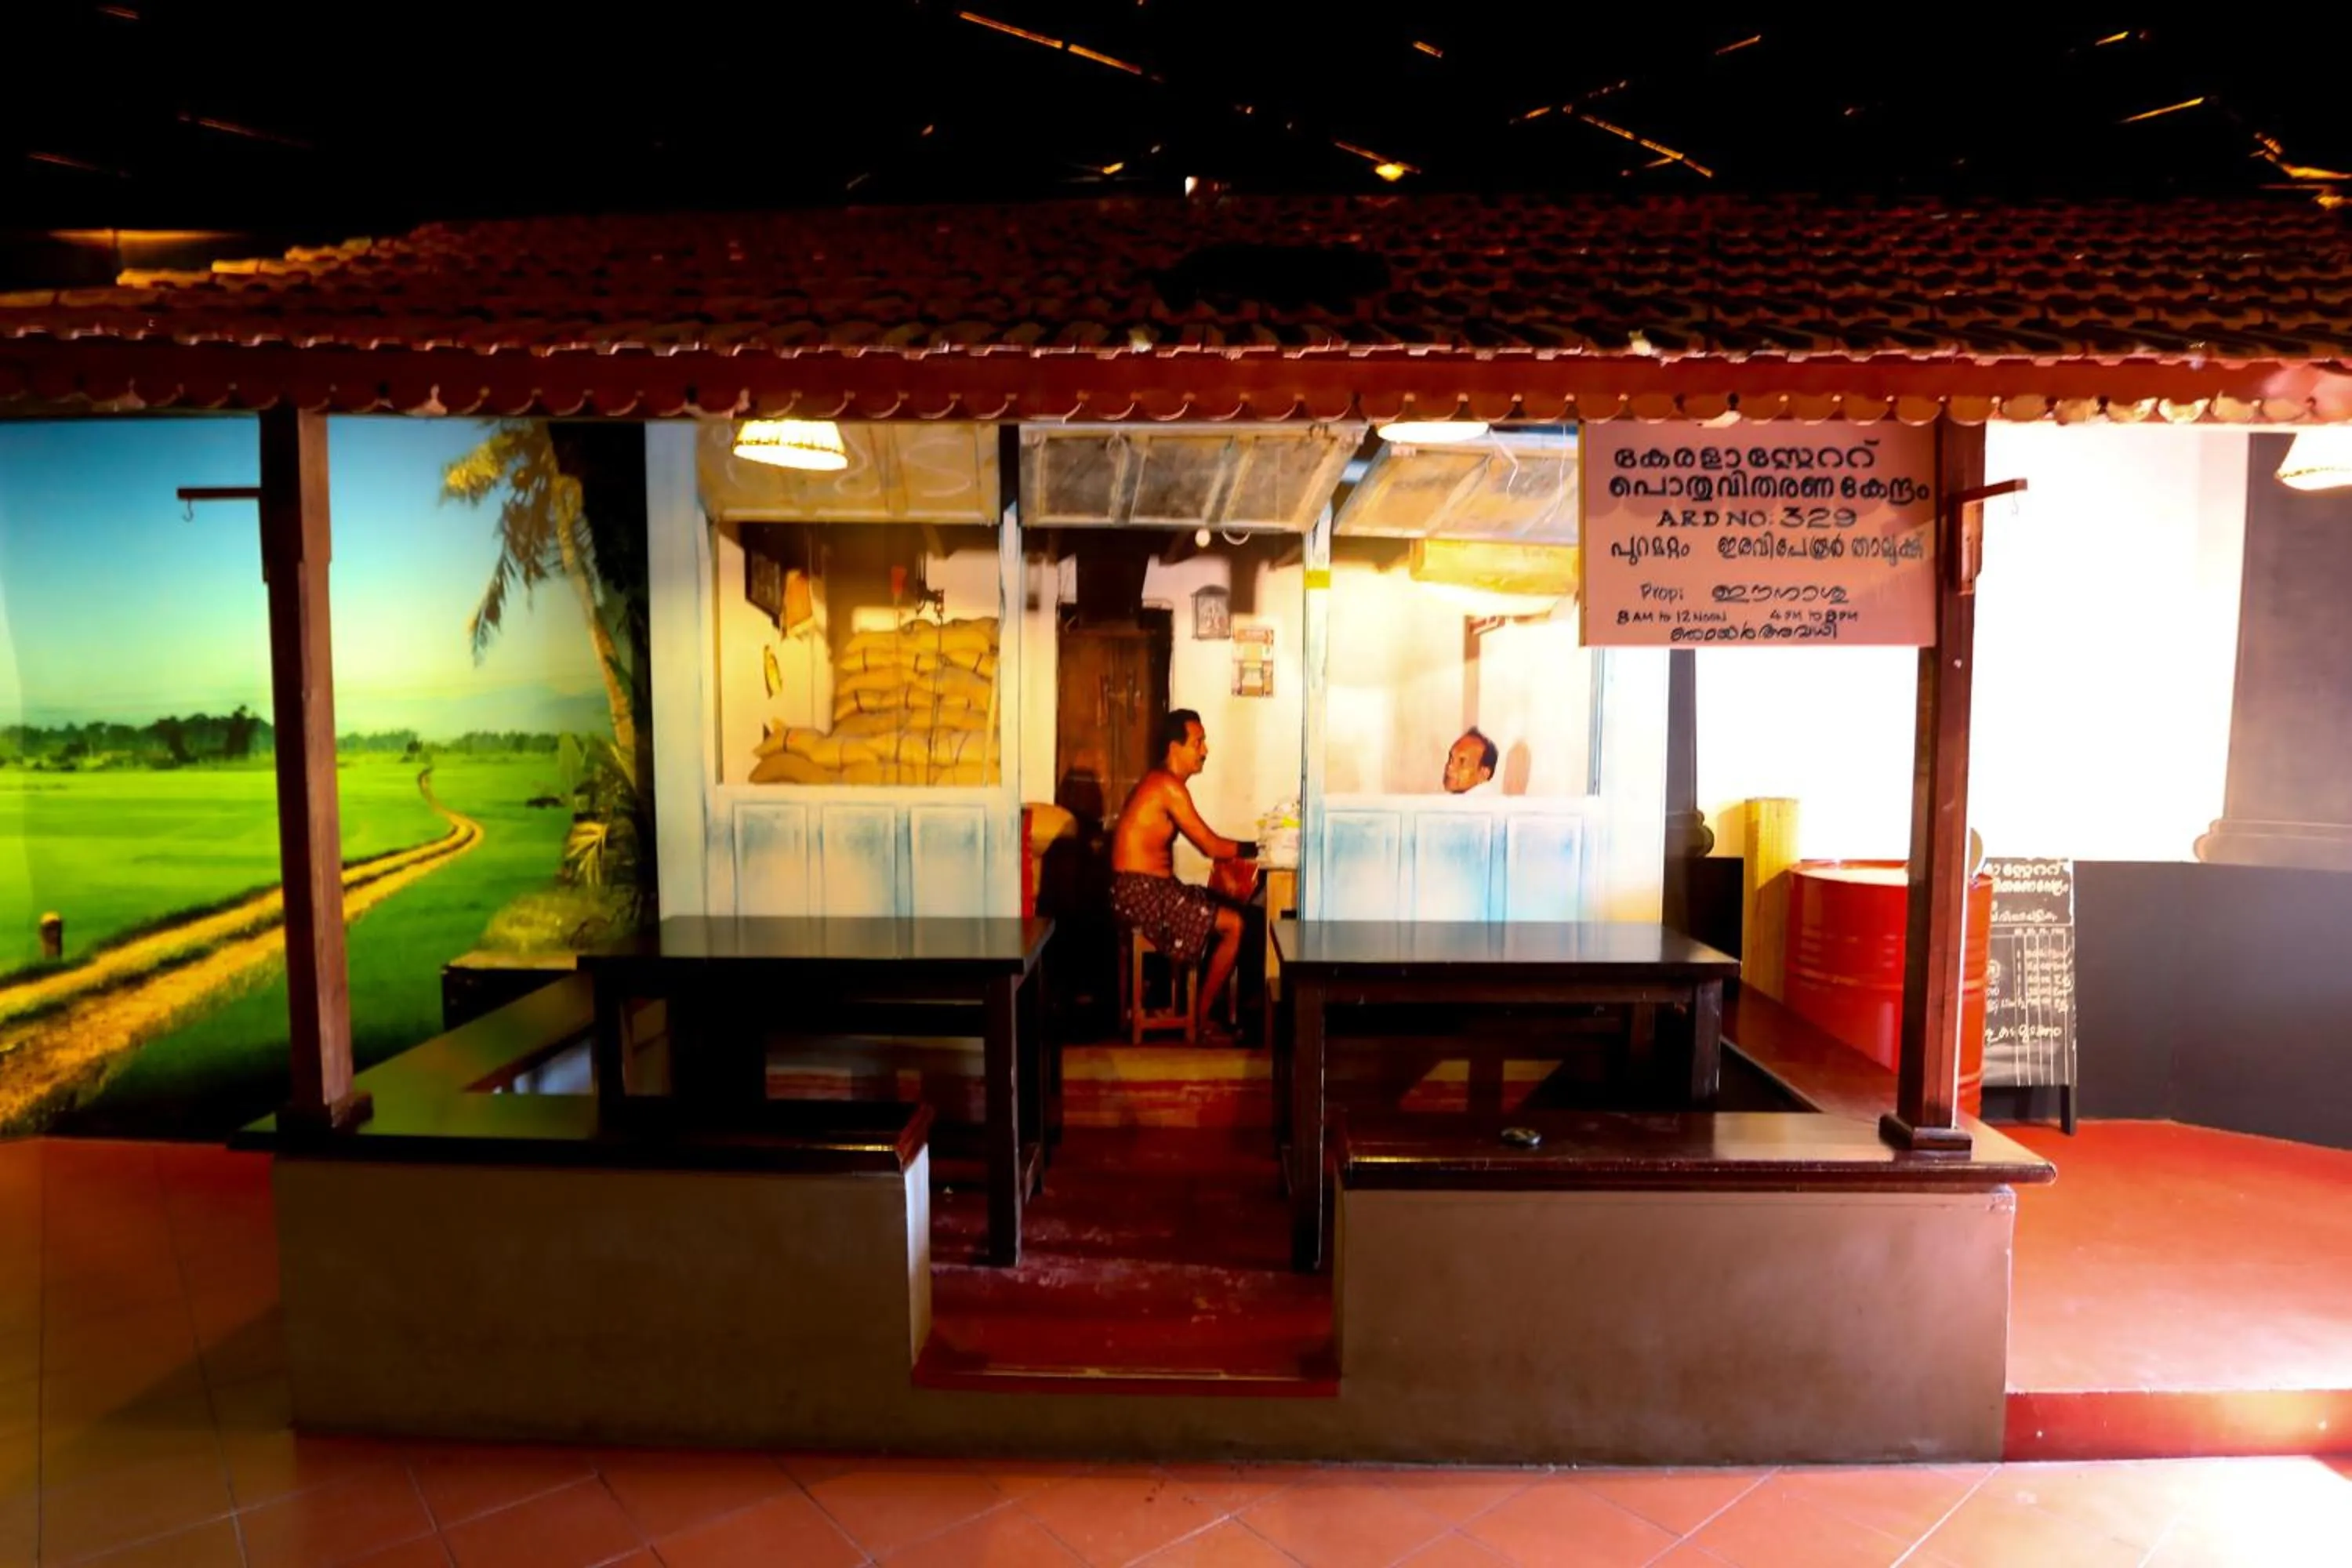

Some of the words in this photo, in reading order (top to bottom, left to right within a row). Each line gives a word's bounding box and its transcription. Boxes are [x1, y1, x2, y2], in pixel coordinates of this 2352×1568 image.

[1614, 447, 1741, 470] കേരളാ
[1656, 510, 1720, 528] ARD
[1779, 506, 1857, 528] 329
[1676, 609, 1691, 623] 12
